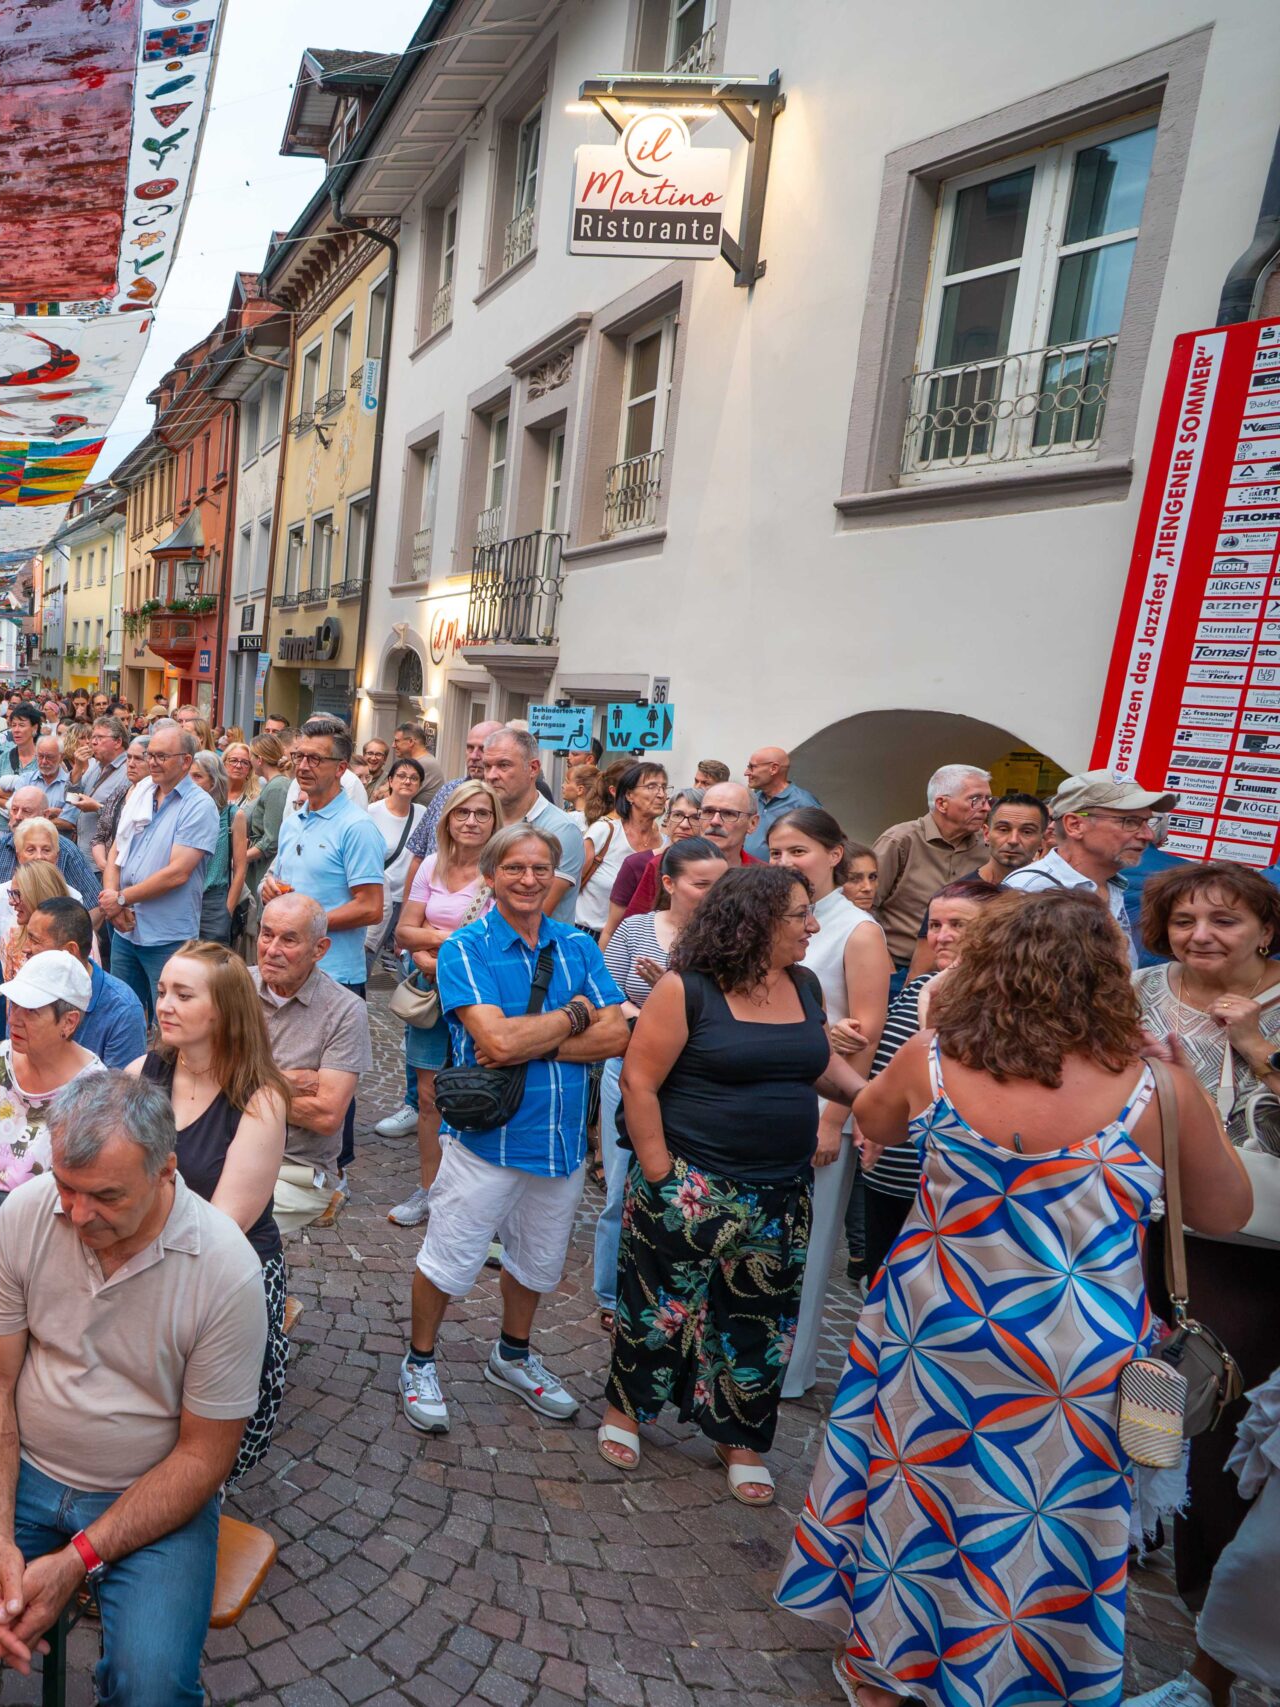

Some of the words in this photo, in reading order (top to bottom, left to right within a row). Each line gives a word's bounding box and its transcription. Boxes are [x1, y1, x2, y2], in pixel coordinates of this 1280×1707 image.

[637, 128, 672, 162] il
[582, 170, 723, 212] Martino
[580, 214, 714, 240] Ristorante
[1209, 580, 1262, 590] JÜRGENS
[1138, 572, 1169, 648] Jazzfest
[1206, 602, 1259, 610] arzner
[1201, 624, 1253, 634] Simmler
[1195, 646, 1251, 659] Tomasi
[1130, 650, 1152, 685] das
[654, 686, 666, 704] 36
[532, 706, 586, 714] Behinderten-WC
[1194, 710, 1234, 718] fressnapf
[1244, 714, 1280, 722] RE/M
[1115, 689, 1144, 773] erstützen
[1170, 754, 1222, 769] 2000
[1184, 776, 1214, 784] Treuhand
[1183, 782, 1218, 790] Hochrhein
[1234, 778, 1278, 794] SCHWARZ
[1186, 800, 1216, 808] ALBIEZ
[1243, 802, 1279, 814] KÖGEL
[1242, 828, 1272, 838] Vinothek
[1170, 842, 1203, 850] ZANOTTI
